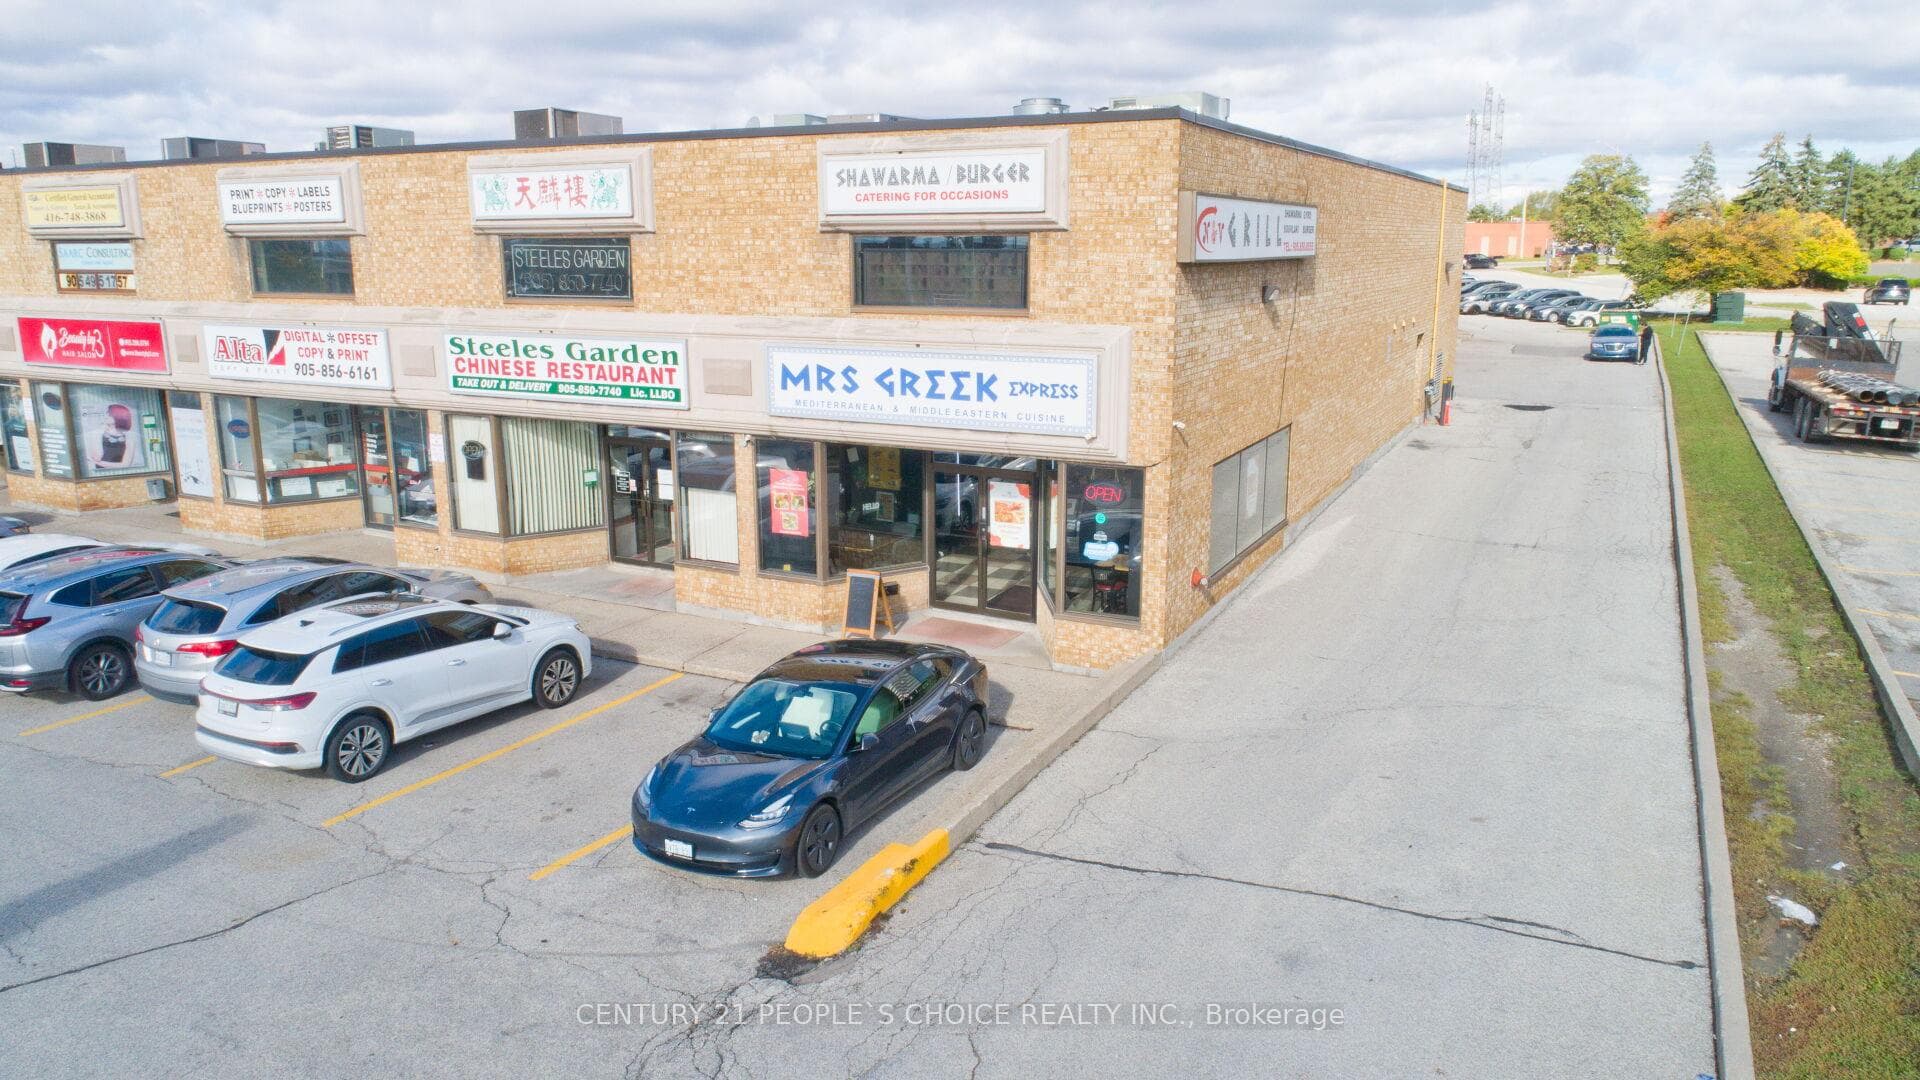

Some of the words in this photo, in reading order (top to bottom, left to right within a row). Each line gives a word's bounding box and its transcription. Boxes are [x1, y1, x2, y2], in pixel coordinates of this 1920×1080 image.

[836, 163, 940, 188] SHAWARMA
[956, 161, 1030, 184] BURGER
[230, 189, 254, 200] PRINT
[265, 187, 286, 198] COPY
[297, 186, 330, 198] LABELS
[855, 191, 910, 202] CATERING
[914, 191, 937, 201] FOR
[940, 189, 1009, 201] OCCASIONS
[44, 211, 107, 222] 416-748-3868
[232, 202, 283, 214] BLUEPRINTS
[294, 201, 332, 212] POSTERS
[1228, 211, 1281, 248] GRILL
[515, 249, 570, 269] STEELES
[573, 249, 625, 269] GARDEN
[284, 330, 325, 343] DIGITAL
[337, 332, 378, 346] OFFSET
[214, 335, 265, 364] Alta
[298, 347, 324, 359] COPY
[327, 348, 335, 359] &
[337, 349, 369, 362] PRINT
[449, 336, 554, 360] Steeles
[565, 342, 679, 366] Garden
[294, 362, 378, 381] 905-856-6161
[454, 356, 536, 378] CHINESE
[547, 361, 677, 385] RESTAURANT
[457, 377, 481, 388] TAKE
[481, 379, 499, 389] OUT
[499, 380, 506, 390] &
[508, 381, 552, 393] DELIVERY
[558, 383, 622, 397] 905-850-7740
[650, 389, 675, 400] LLBO
[780, 363, 859, 394] MRS
[874, 366, 998, 403] GREEK
[1008, 381, 1080, 400] EXPRESS
[795, 399, 884, 412] MEDITERRANEAN
[909, 406, 951, 417] MIDDLE
[954, 408, 1008, 420] EASTERN
[1017, 412, 1066, 424] CUISINE
[1085, 485, 1122, 502] OPEN
